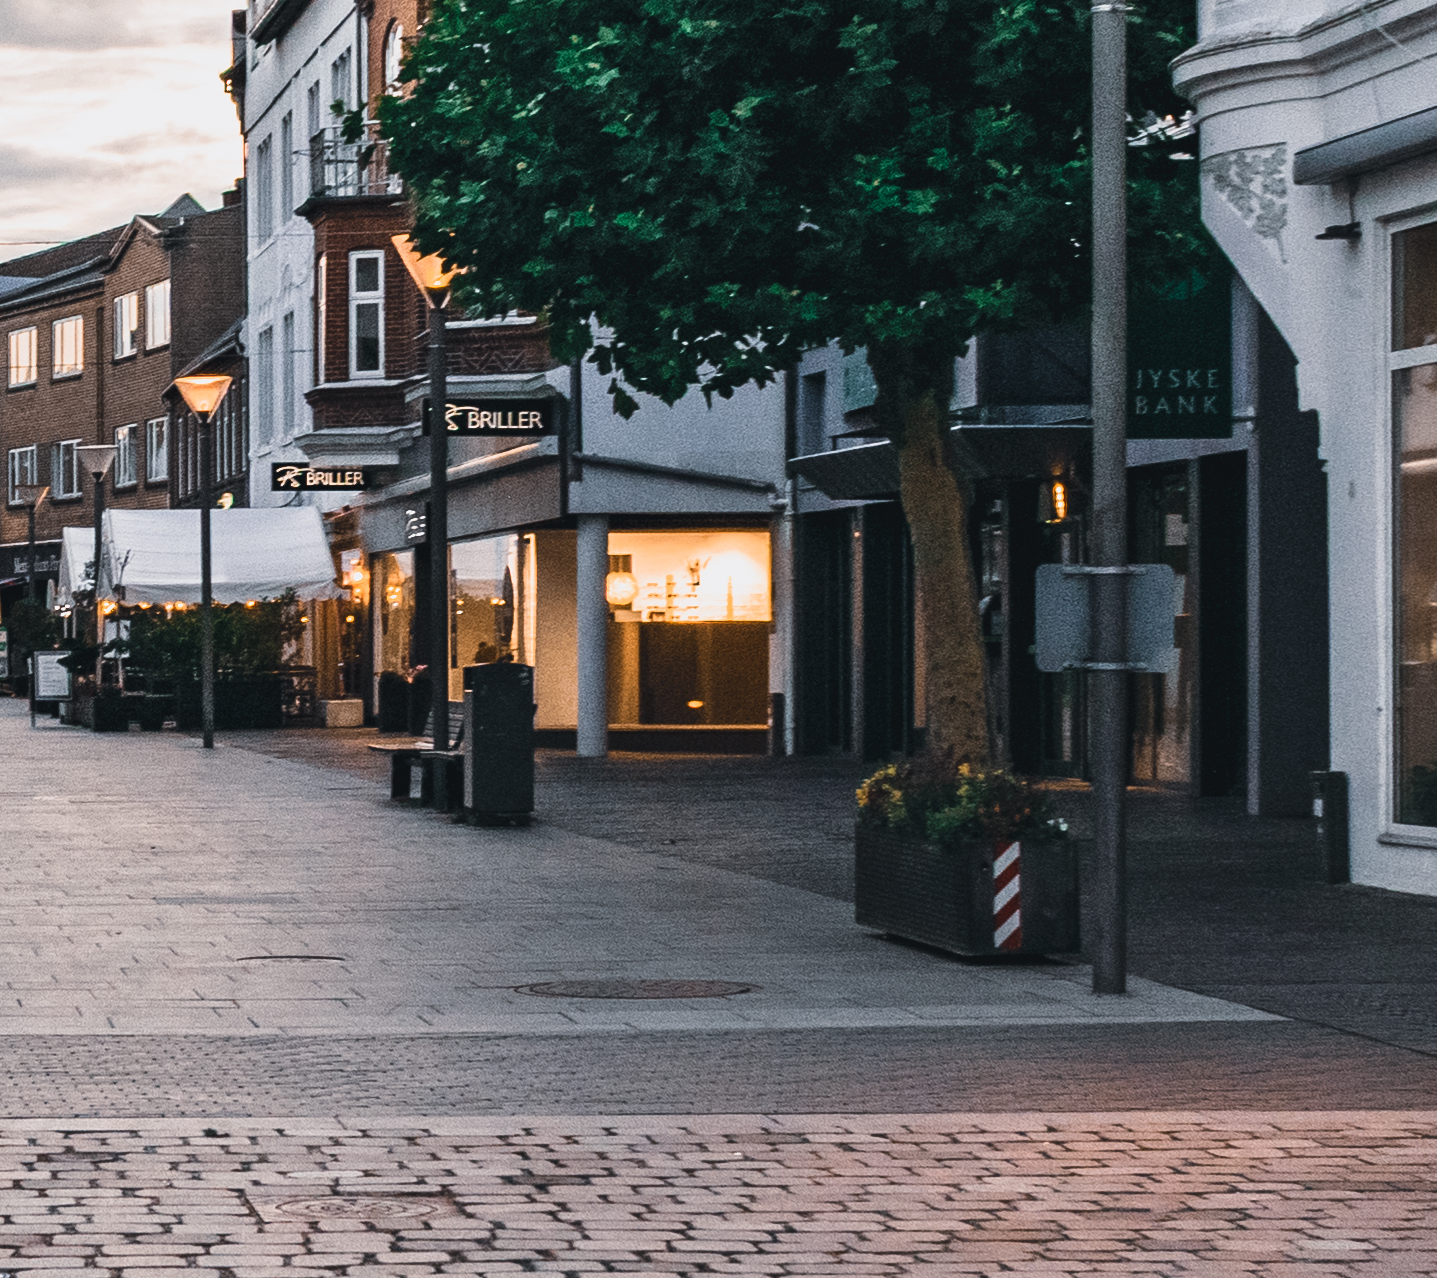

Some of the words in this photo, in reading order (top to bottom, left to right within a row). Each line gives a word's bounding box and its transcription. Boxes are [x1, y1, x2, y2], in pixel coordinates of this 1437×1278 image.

[1136, 369, 1219, 389] JYSKE
[1135, 395, 1219, 415] BANK
[467, 411, 543, 429] BRILLER
[306, 471, 365, 486] BRILLER
